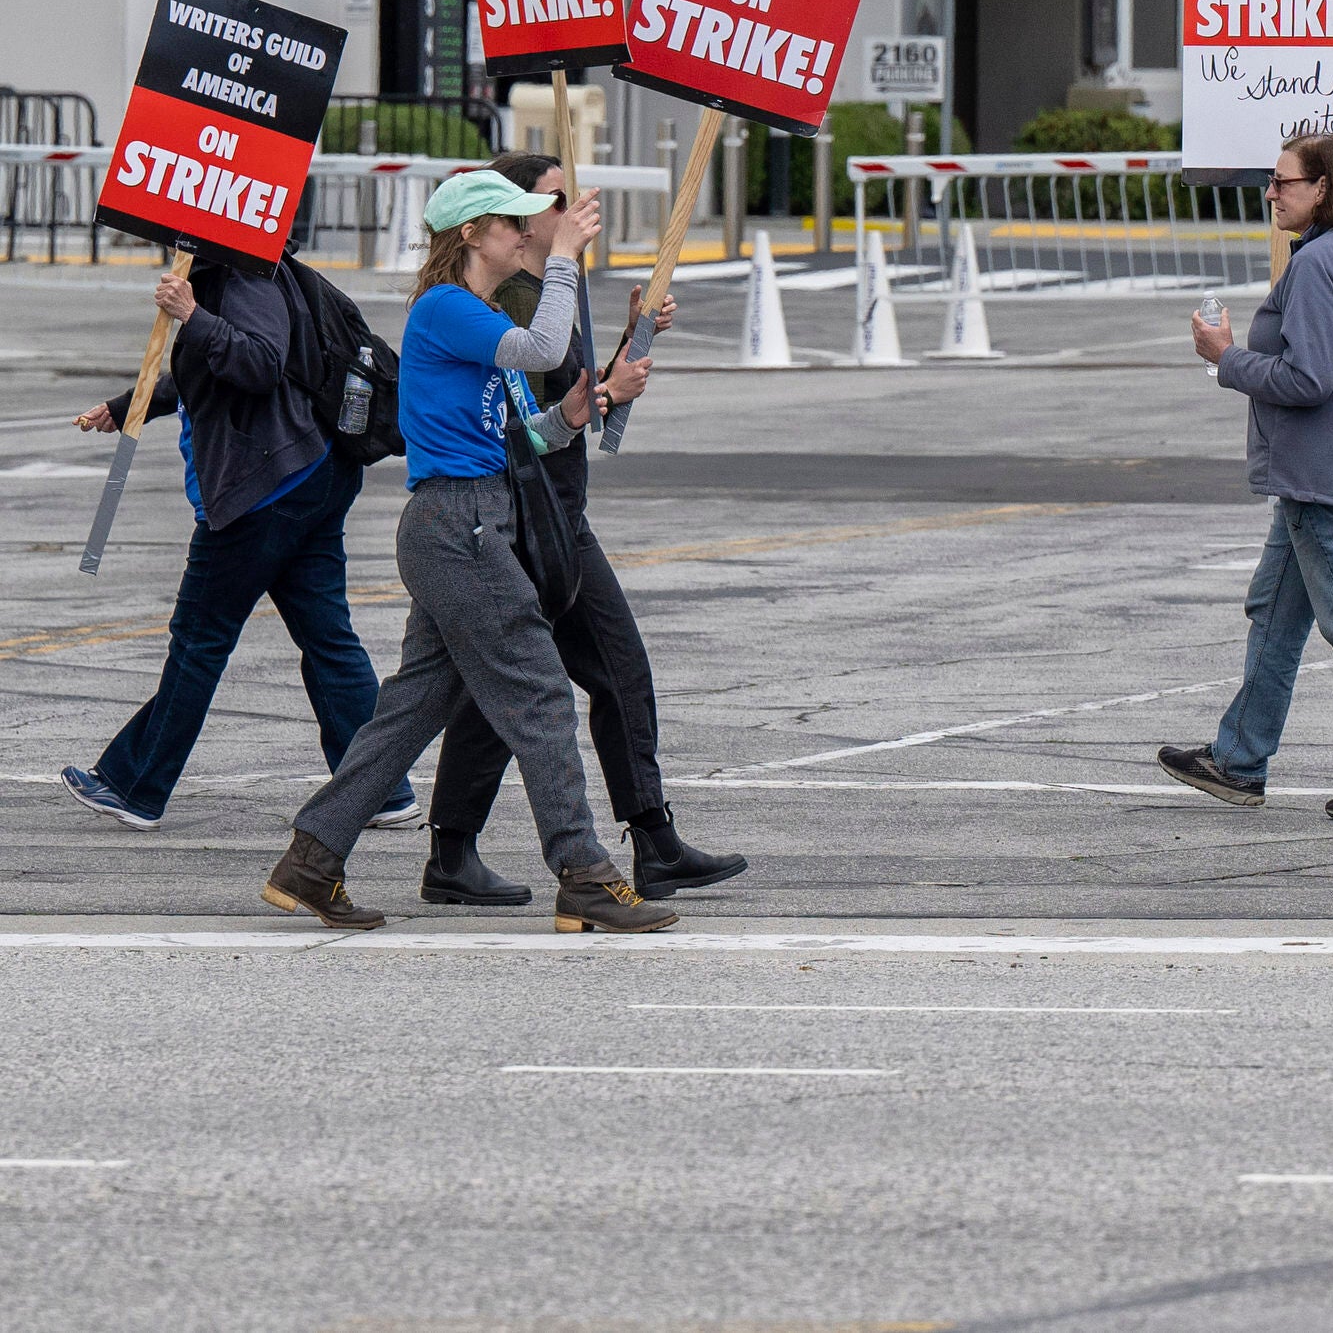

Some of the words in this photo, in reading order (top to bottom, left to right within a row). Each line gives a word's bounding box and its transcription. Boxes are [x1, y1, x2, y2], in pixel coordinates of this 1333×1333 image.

[169, 0, 264, 51] WRITERS
[265, 33, 327, 71] GUILD
[227, 53, 253, 75] OF
[872, 43, 937, 65] 2160
[1201, 46, 1247, 82] We
[181, 68, 278, 118] AMERICA
[198, 125, 239, 161] ON
[116, 140, 289, 234] STRIKE!
